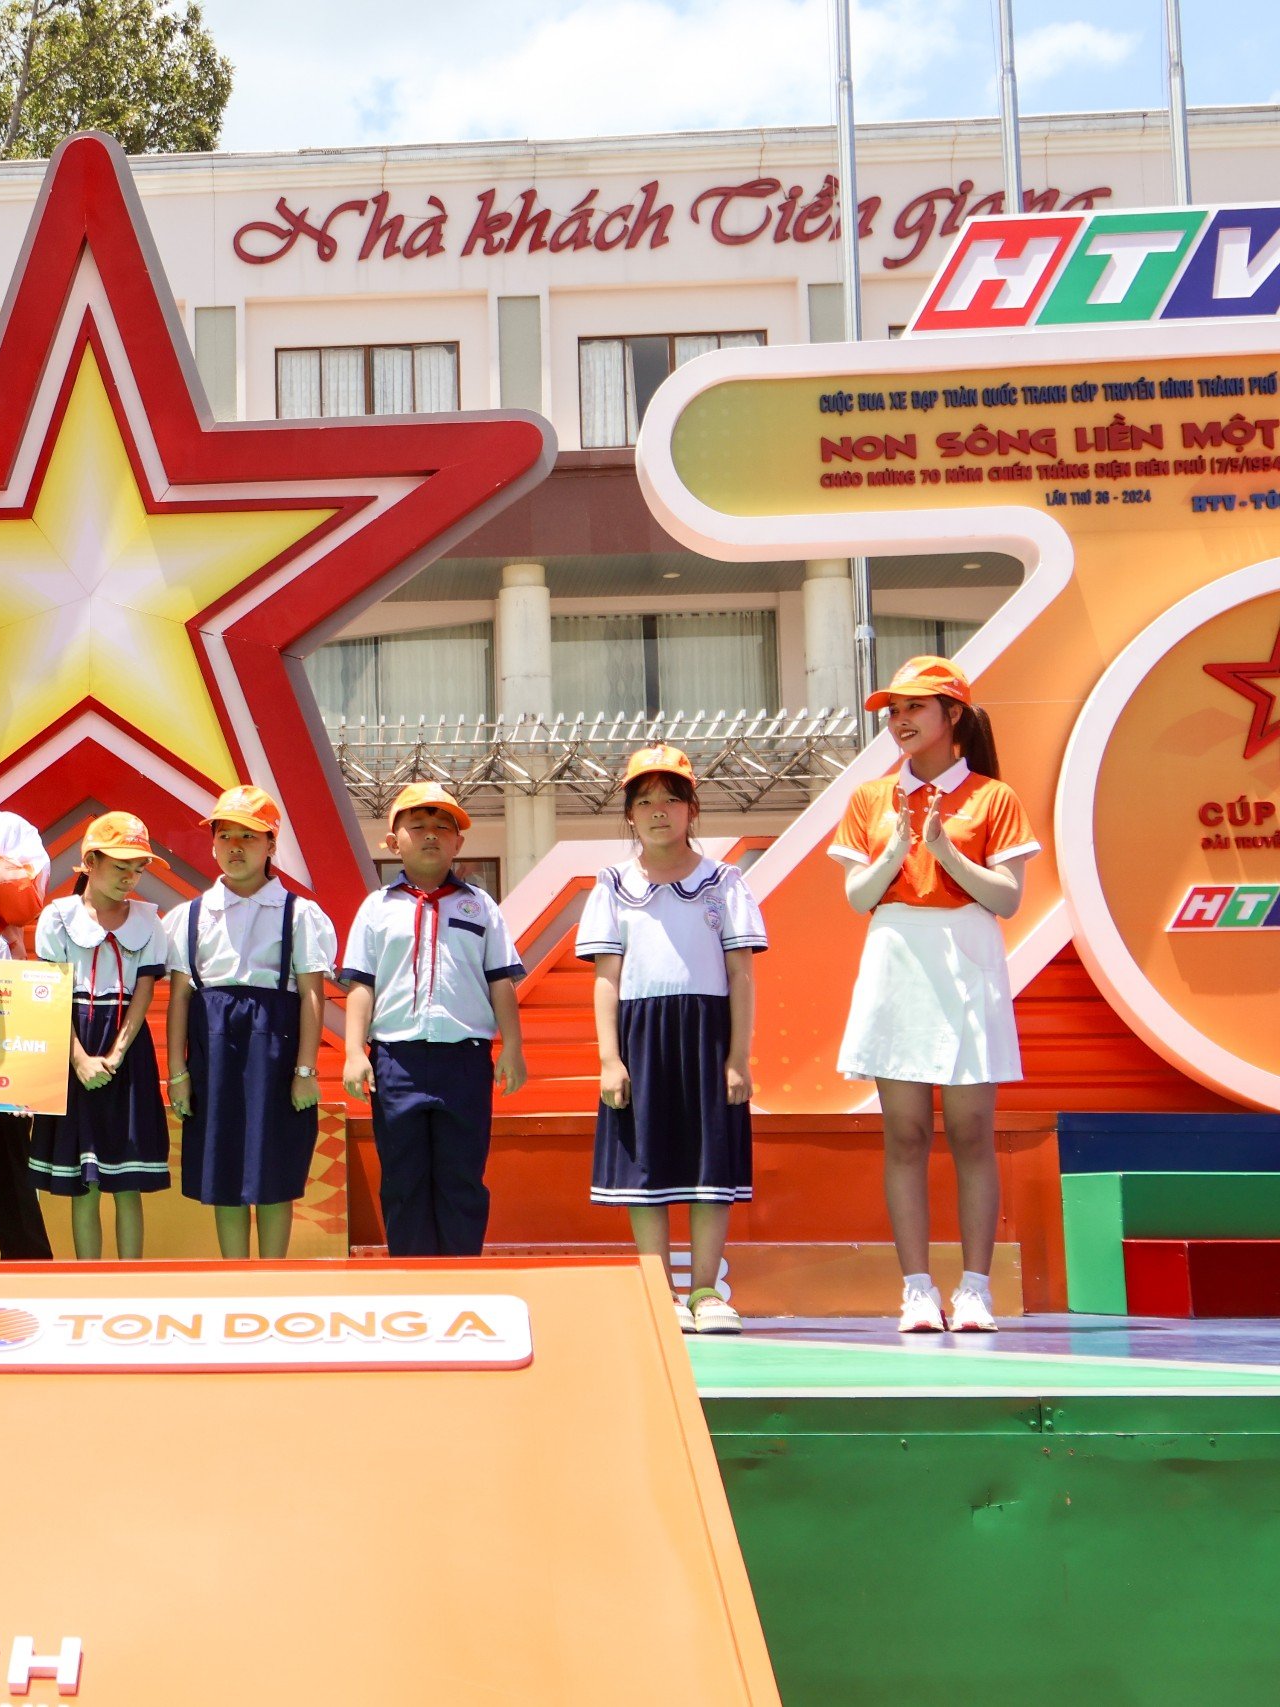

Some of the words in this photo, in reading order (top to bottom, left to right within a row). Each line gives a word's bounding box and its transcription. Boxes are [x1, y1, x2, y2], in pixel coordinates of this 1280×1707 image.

[233, 190, 448, 265] Nhà
[460, 180, 674, 257] khách
[933, 228, 1280, 312] HTV
[819, 390, 853, 416] CUỘC
[858, 392, 885, 410] ĐUA
[890, 391, 907, 411] XE
[911, 389, 939, 413] ĐẠP
[943, 385, 978, 408] TOÀN
[982, 382, 1017, 407] QUỐC
[1021, 385, 1067, 405] TRANH
[1071, 381, 1099, 403] CÚP
[1102, 377, 1155, 401] TRUYỀN
[1160, 377, 1194, 399] HÌNH
[1198, 374, 1245, 398] THÀNH
[1249, 371, 1278, 396] PHỐ
[820, 434, 917, 463] NON
[935, 423, 1057, 459] SÔNG
[1074, 413, 1164, 453] LIỀN
[1181, 413, 1280, 453] MỘT
[820, 470, 863, 488] CHÀO
[867, 467, 915, 487] MỪNG
[920, 469, 941, 484] 70
[945, 465, 983, 484] NĂM
[988, 461, 1033, 481] CHIẾN
[1037, 458, 1090, 480] THẮNG
[1094, 460, 1131, 481] ĐIỆN
[1135, 458, 1170, 476] BIÊN
[1174, 455, 1206, 476] PHỦ
[1045, 489, 1067, 506] LẦN
[1070, 488, 1091, 505] THỨ
[1095, 490, 1110, 504] 36
[1122, 489, 1151, 504] 2024
[1192, 494, 1236, 512] HTV
[1199, 795, 1276, 827] CÚP
[1201, 833, 1230, 850] ĐÀI
[3, 1037, 47, 1053] CẢNH
[57, 1313, 206, 1342] TON
[223, 1311, 429, 1341] DONG
[442, 1310, 499, 1340] A
